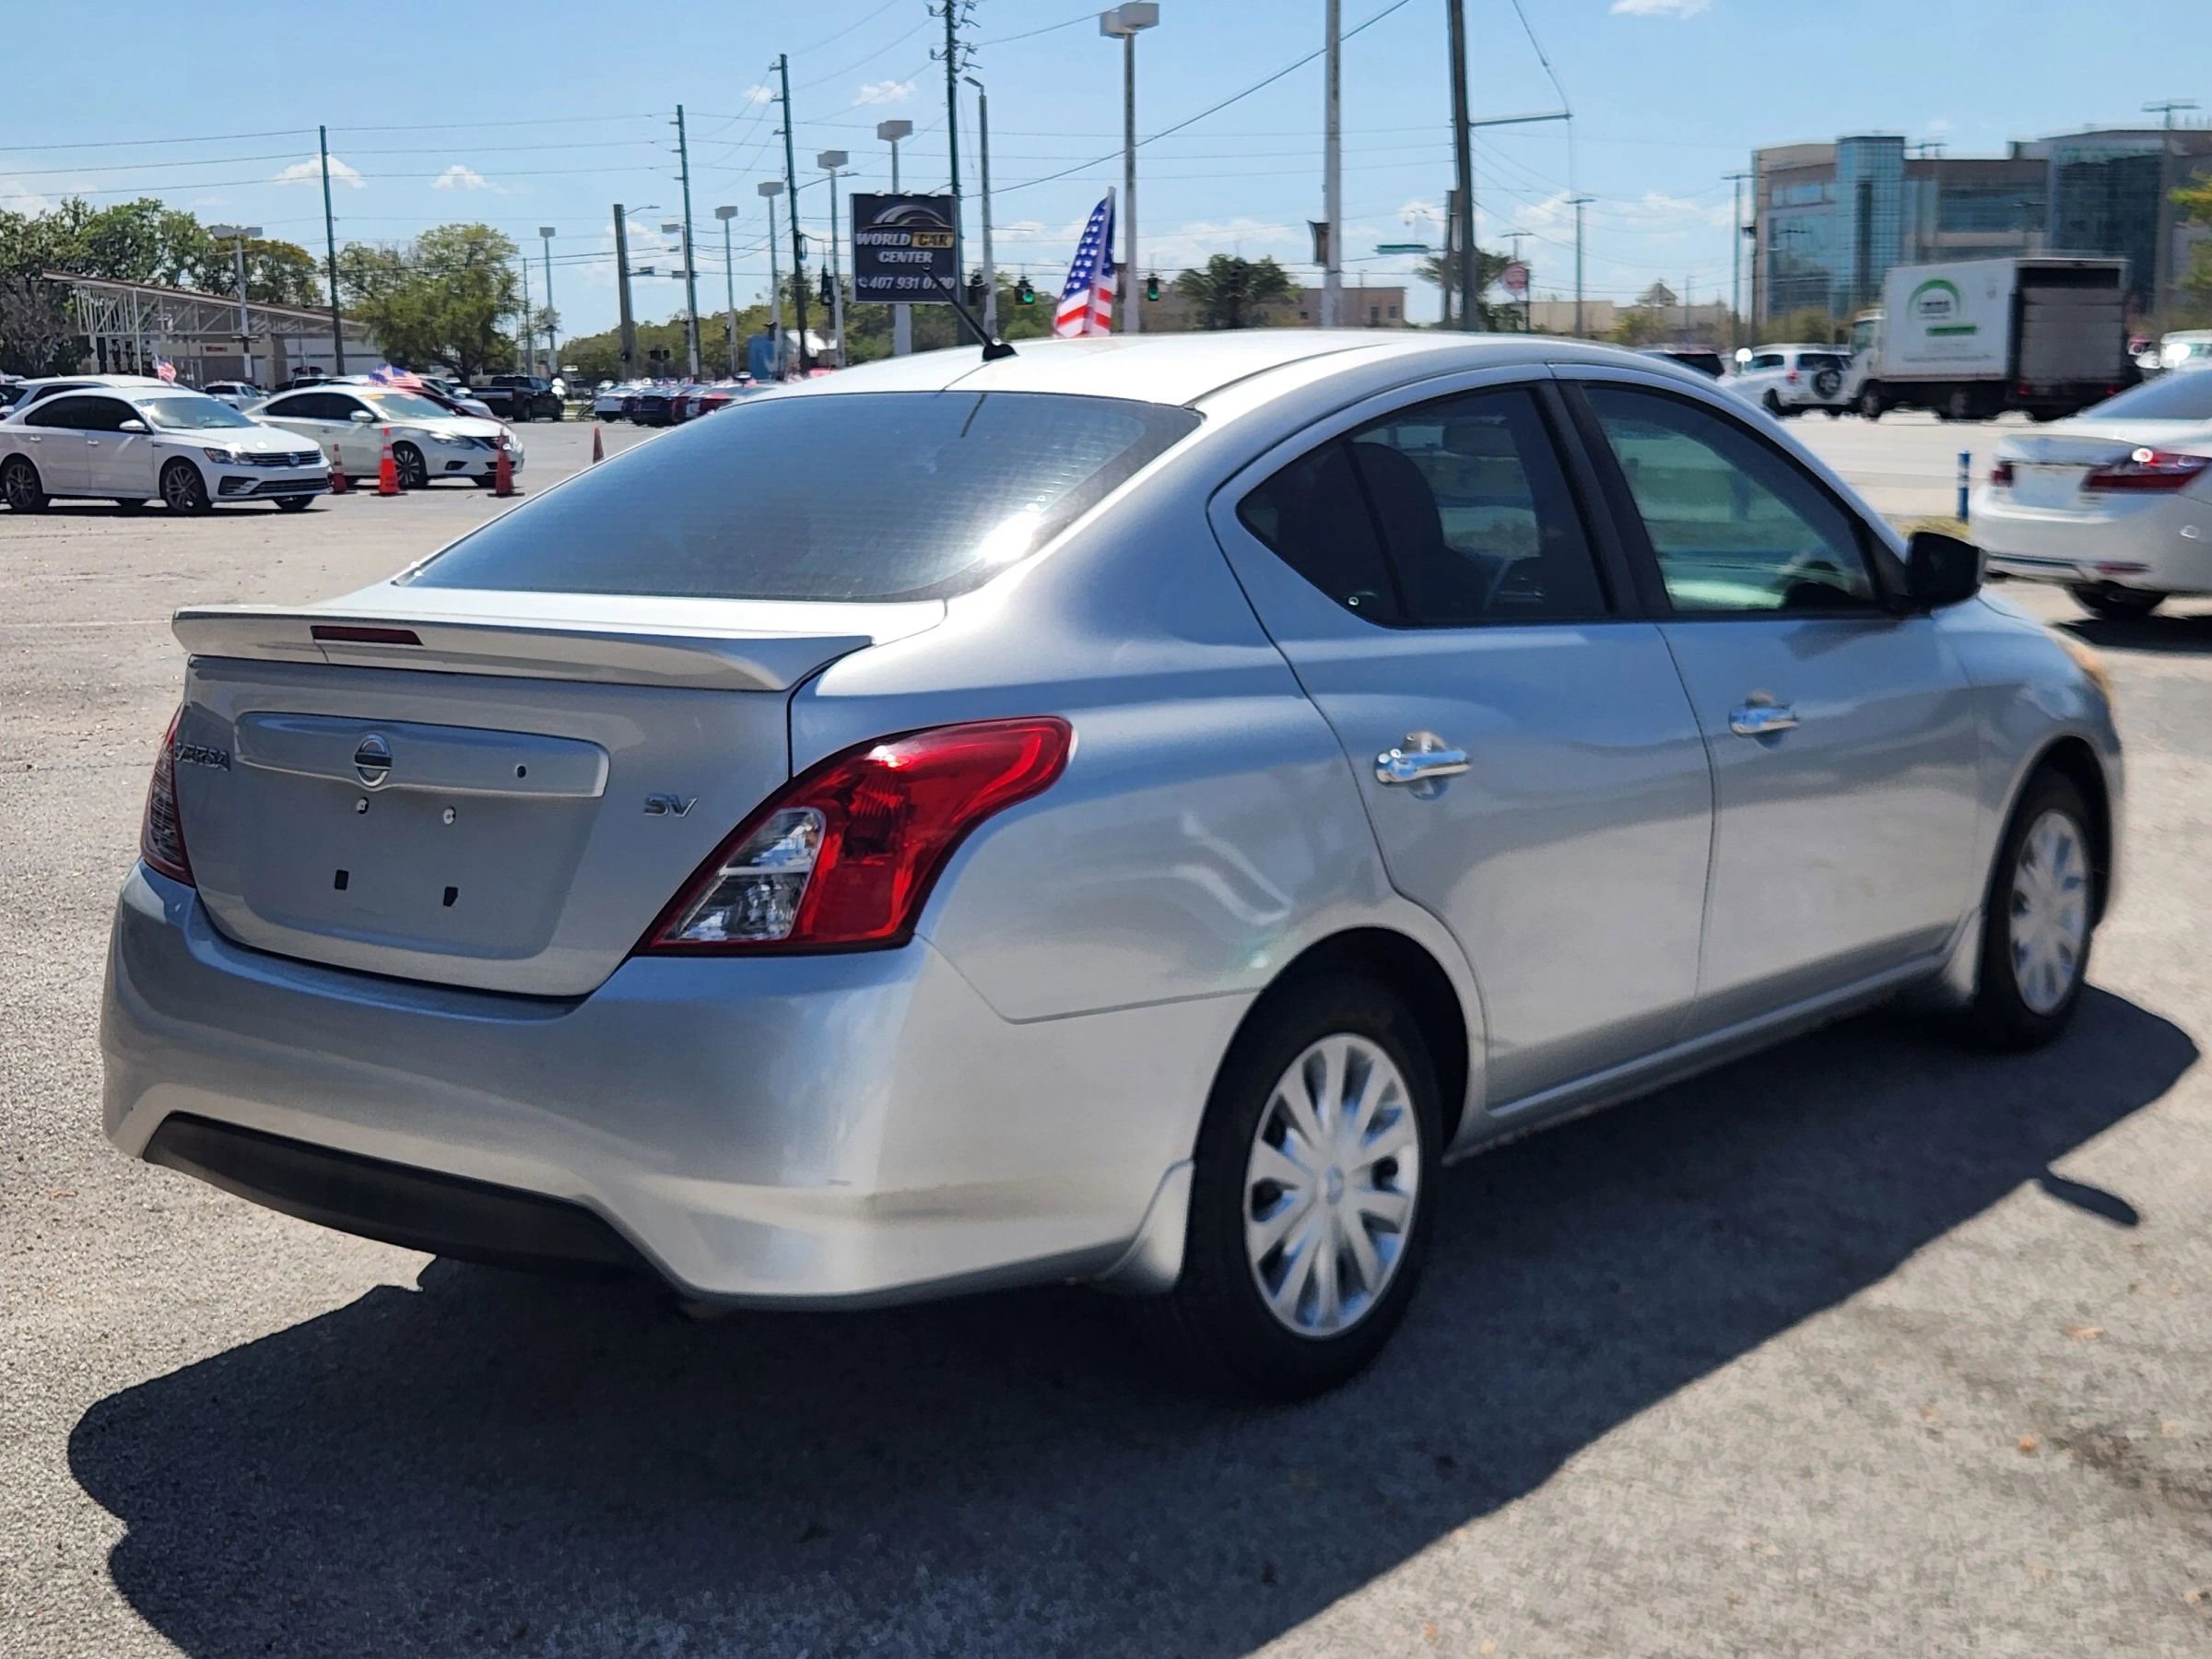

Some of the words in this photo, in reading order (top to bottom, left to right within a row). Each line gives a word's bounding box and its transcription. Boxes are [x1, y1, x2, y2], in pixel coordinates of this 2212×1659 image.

[855, 232, 911, 245] WORLD
[917, 234, 948, 246] CAR
[878, 251, 933, 263] CENTER
[869, 276, 894, 288] 407
[896, 276, 920, 288] 931
[176, 742, 229, 771] VERSA
[644, 794, 698, 818] SV
